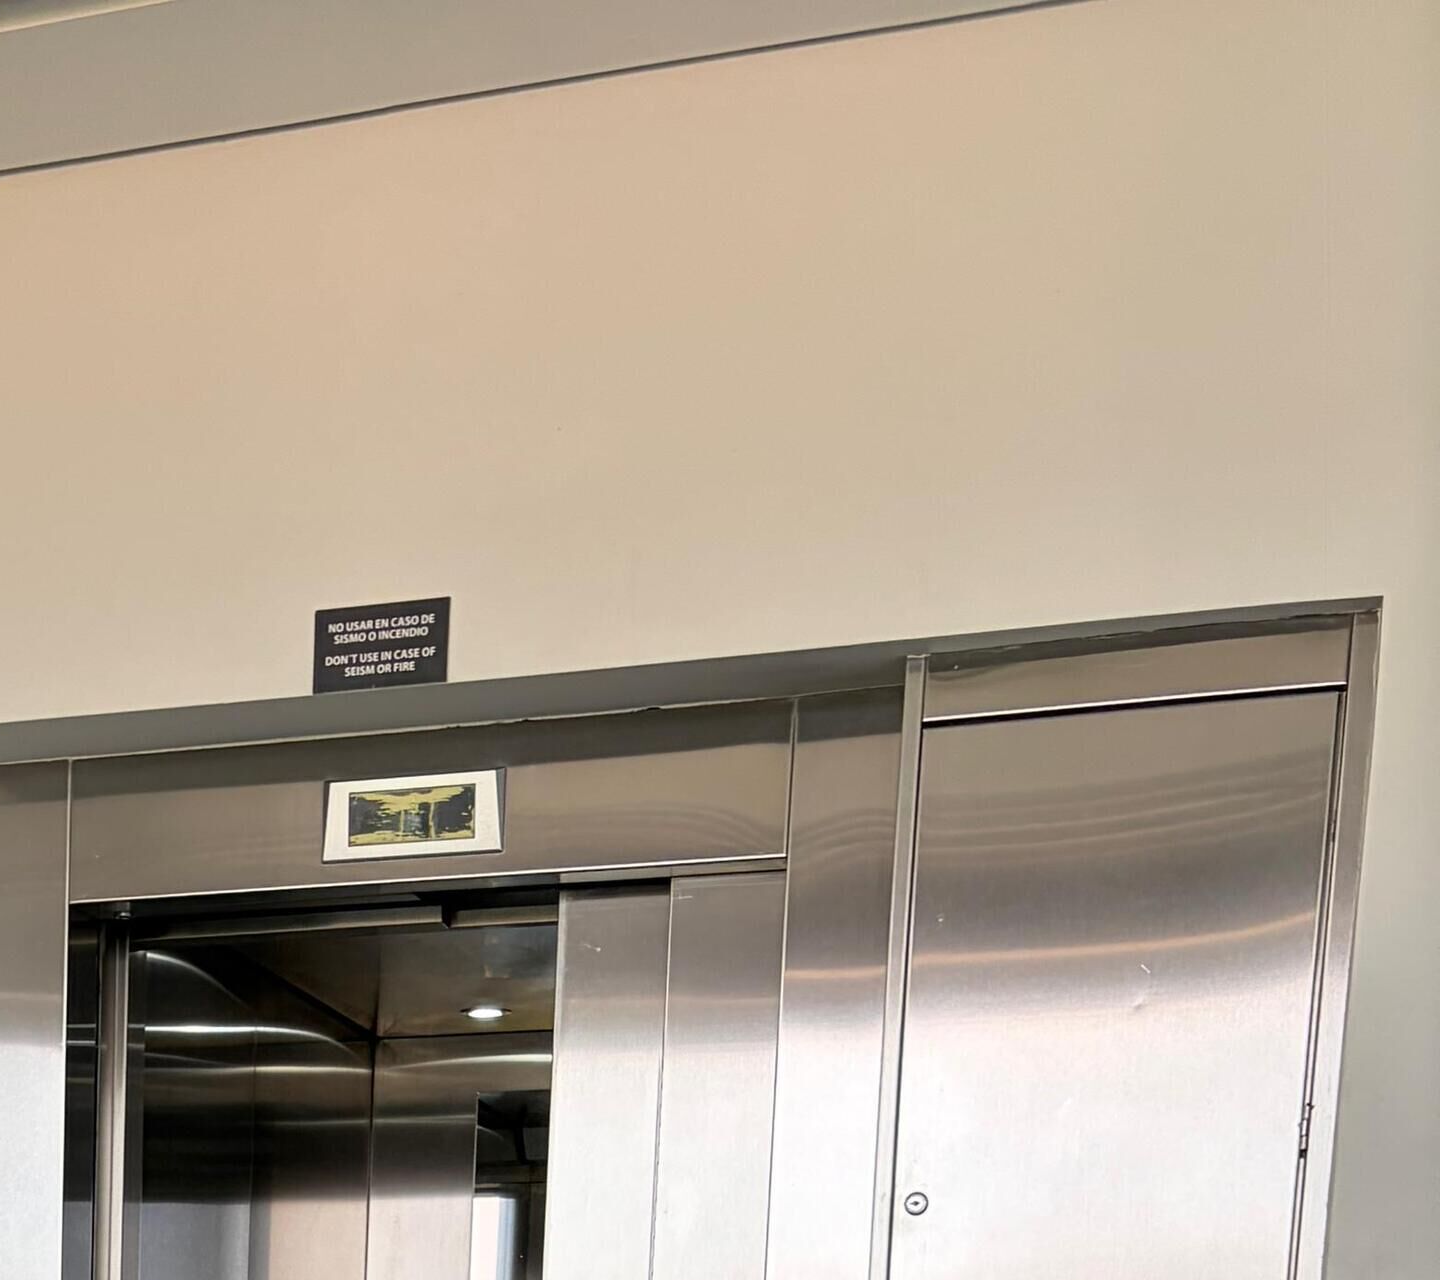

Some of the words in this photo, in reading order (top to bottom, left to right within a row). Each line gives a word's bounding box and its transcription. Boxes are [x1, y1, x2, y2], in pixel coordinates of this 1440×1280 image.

[328, 623, 345, 633] NO
[345, 620, 374, 632] USAR
[375, 618, 390, 629] EN
[391, 615, 419, 627] CASO
[421, 613, 436, 624] DE
[333, 632, 367, 645] SISMO
[368, 631, 377, 641] O
[378, 626, 429, 640] INCENDIO
[324, 654, 358, 666] DON'T
[360, 652, 379, 663] USE
[380, 651, 392, 661] IN
[394, 648, 420, 660] CASE
[421, 646, 437, 657] OF
[344, 664, 375, 677] SEISM
[376, 663, 392, 674] OR
[393, 661, 416, 672] FIRE
